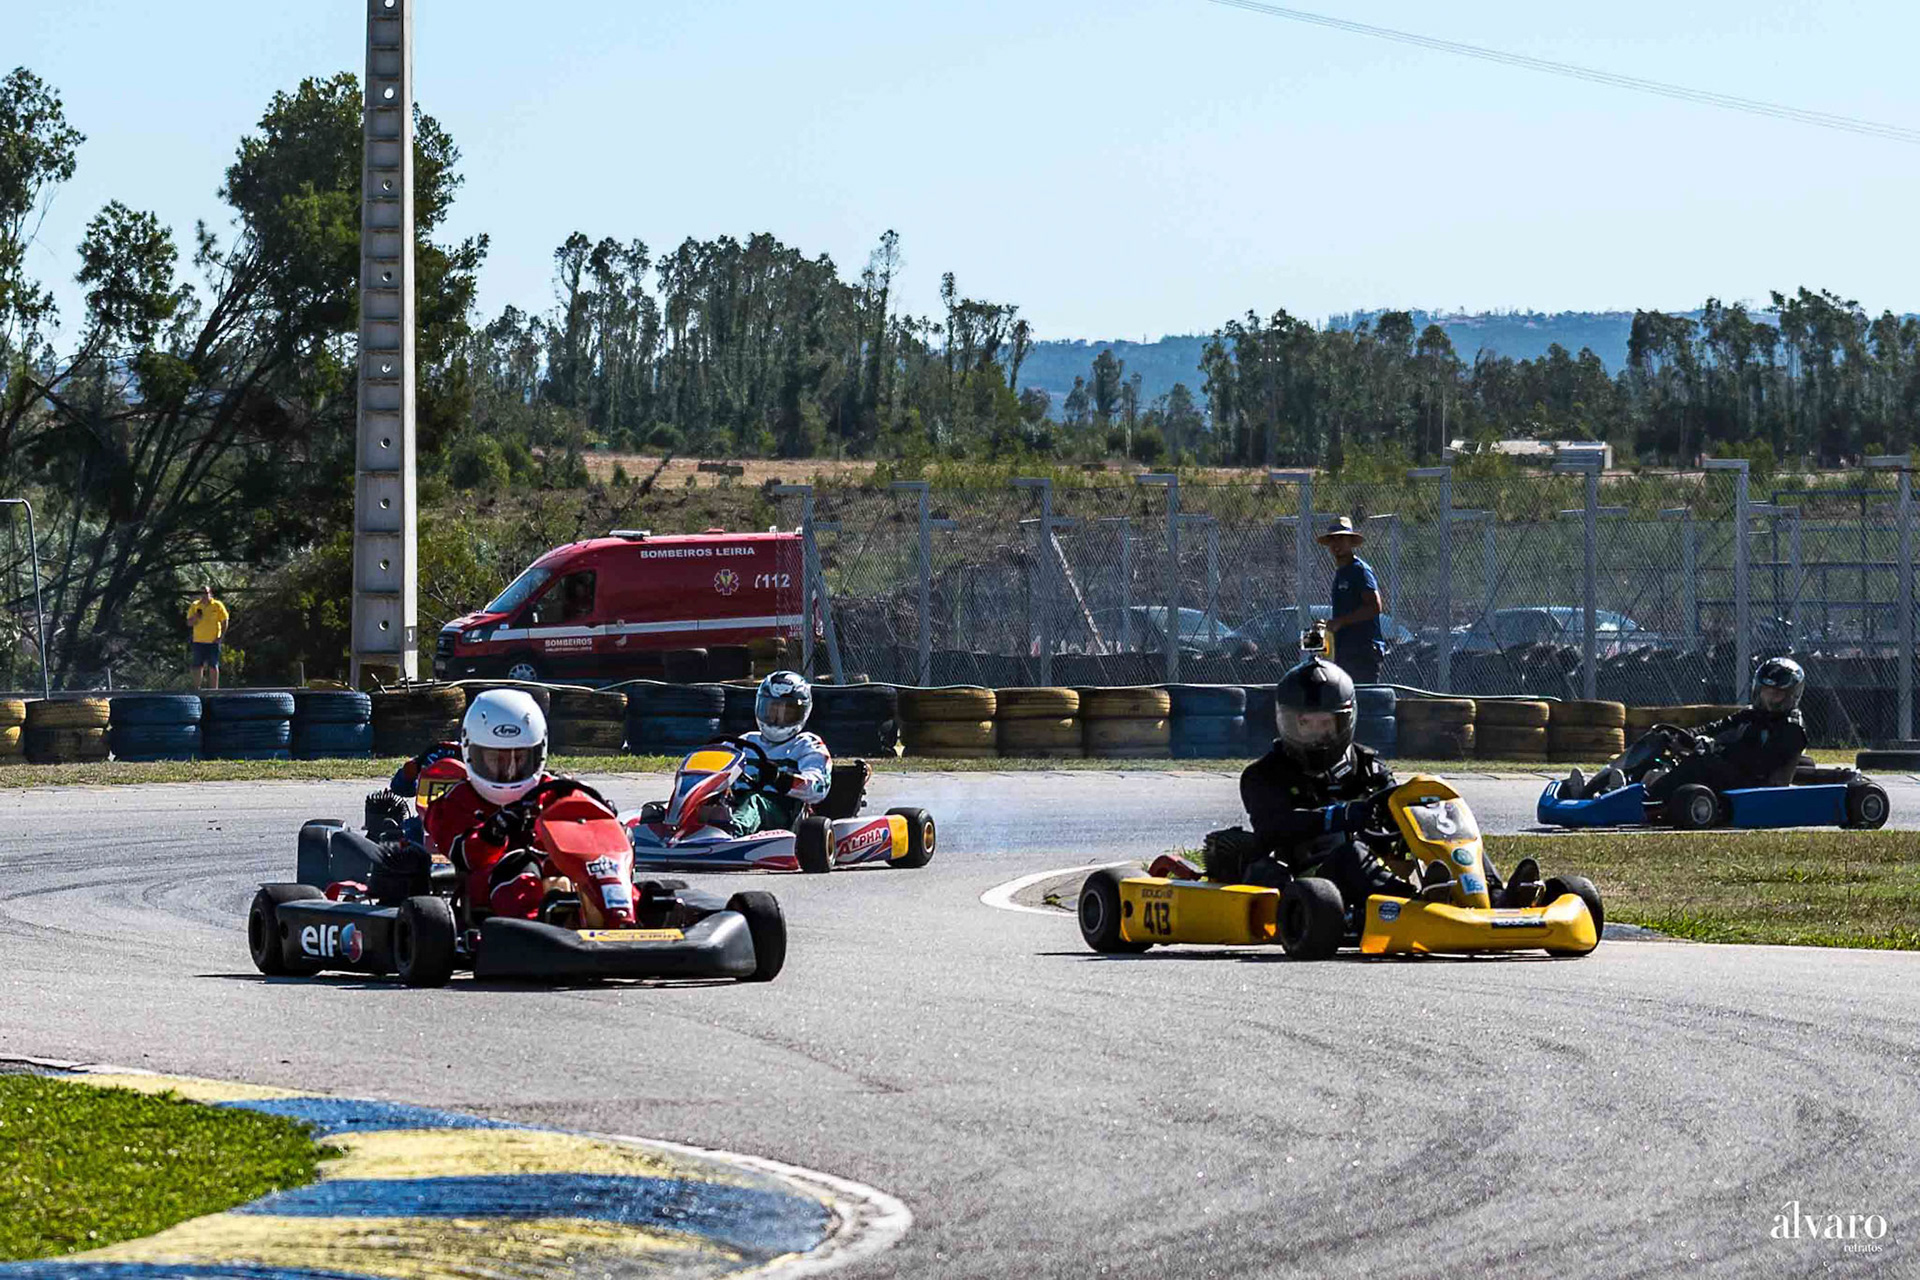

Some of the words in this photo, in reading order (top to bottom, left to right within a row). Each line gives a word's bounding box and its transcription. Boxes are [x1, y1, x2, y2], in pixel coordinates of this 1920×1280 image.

[640, 548, 712, 559] BOMBEIROS
[716, 546, 755, 556] LEIRIA
[761, 573, 790, 589] 112
[545, 638, 593, 647] BOMBEIROS
[836, 828, 883, 857] ALPHA
[1143, 900, 1172, 936] 413
[301, 924, 339, 957] elf
